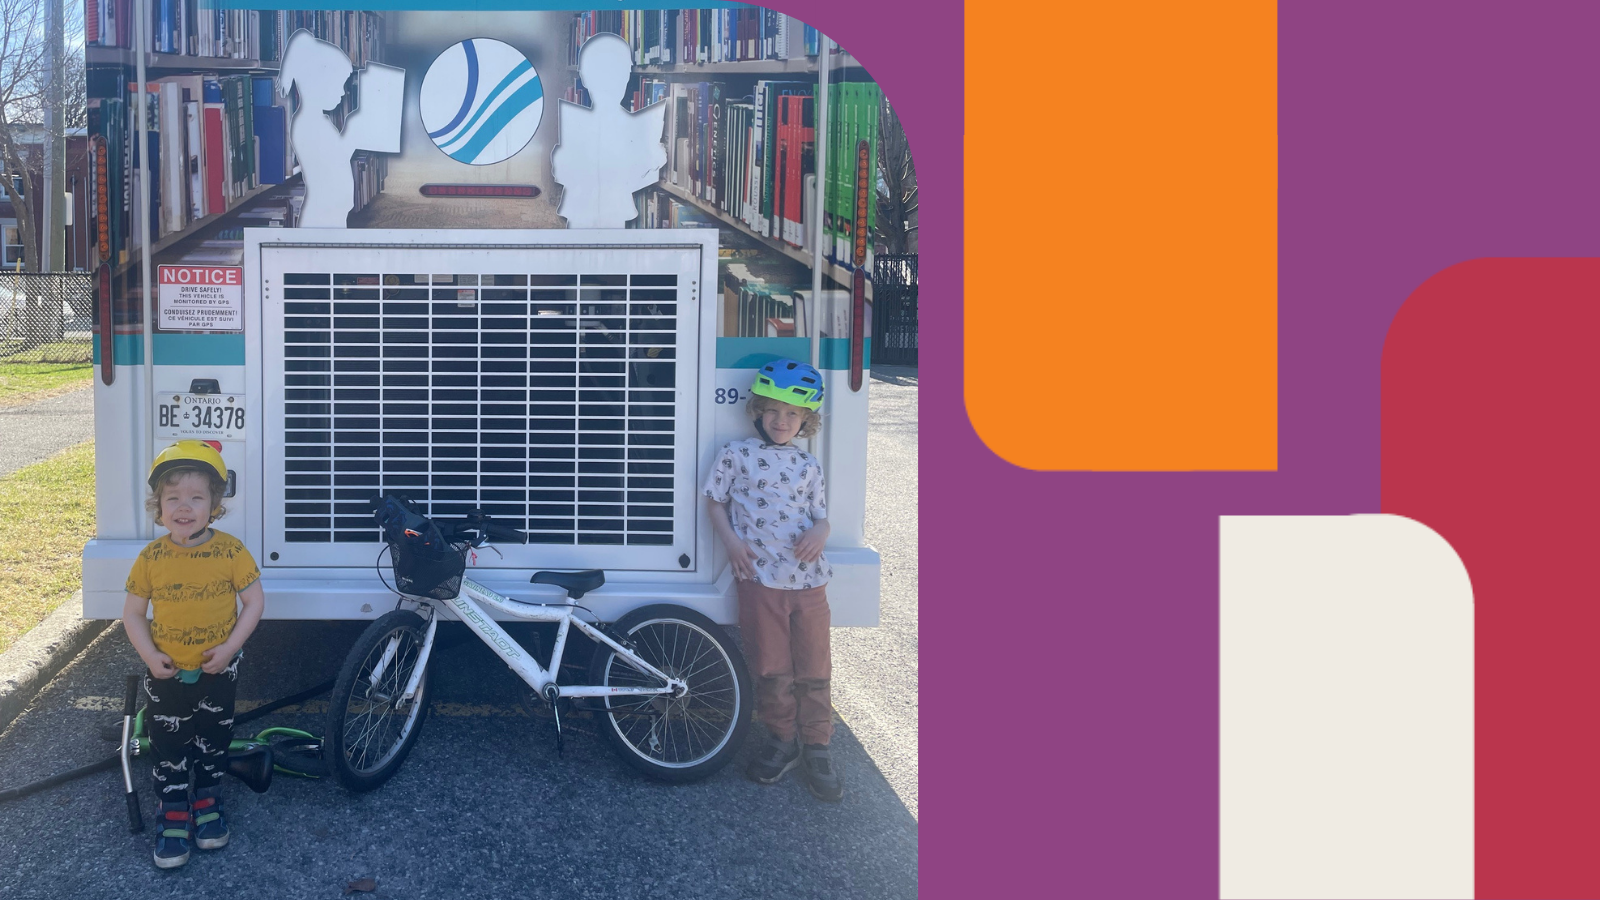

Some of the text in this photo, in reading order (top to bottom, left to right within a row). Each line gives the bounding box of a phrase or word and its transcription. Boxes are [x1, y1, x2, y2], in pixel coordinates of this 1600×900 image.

[163, 268, 237, 284] NOTICE
[159, 404, 245, 429] BE 34378
[449, 596, 521, 657] UNSTADT
